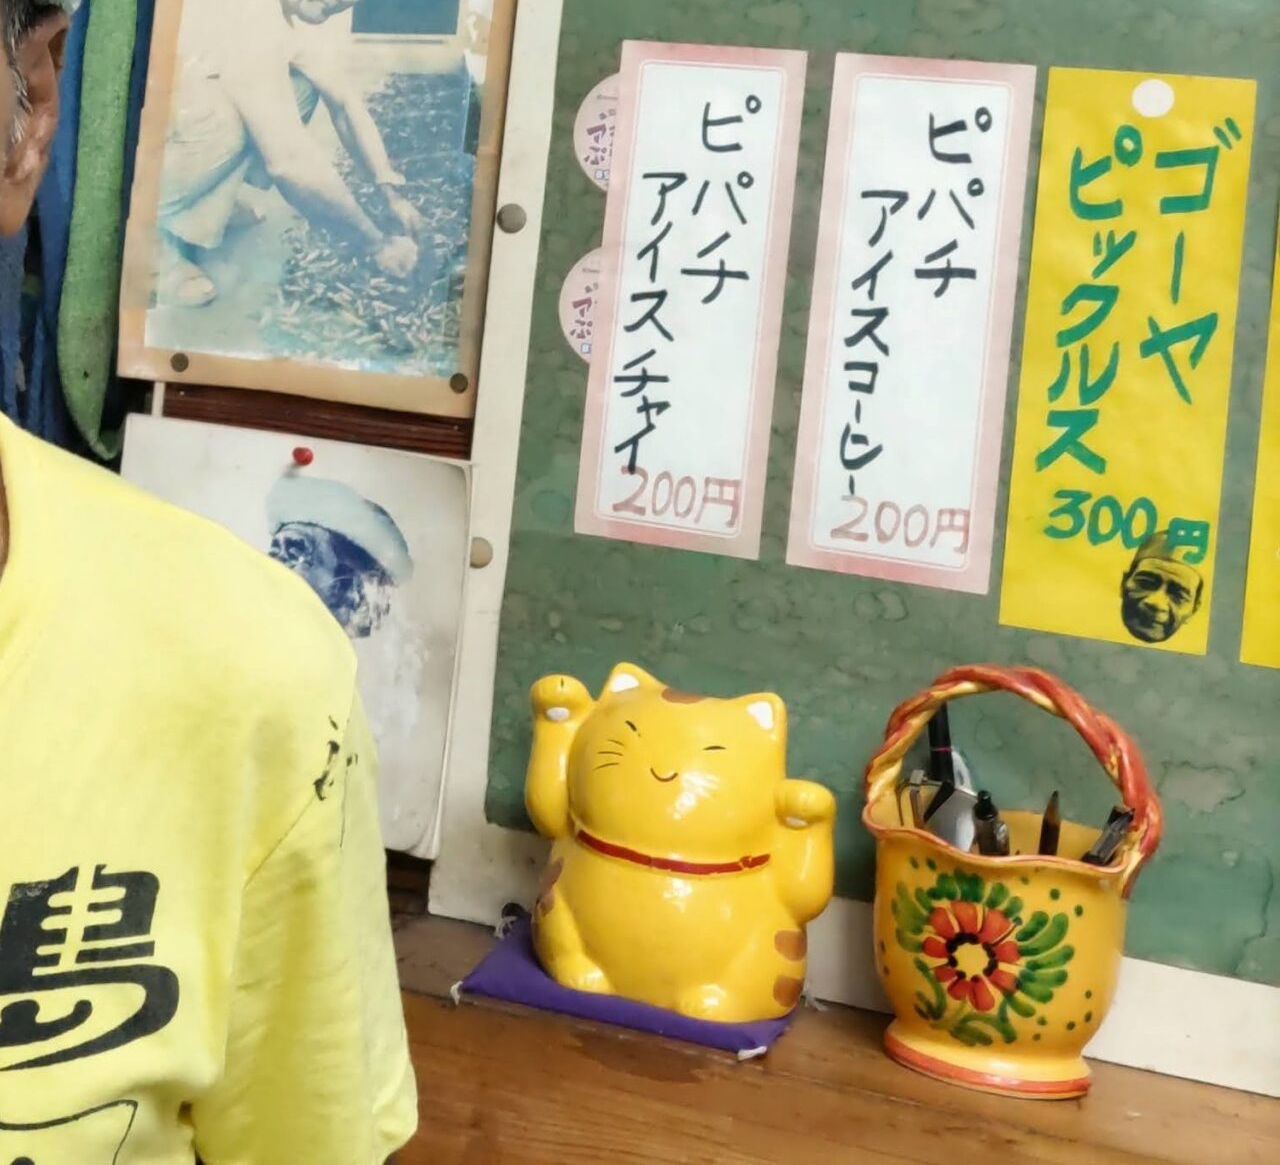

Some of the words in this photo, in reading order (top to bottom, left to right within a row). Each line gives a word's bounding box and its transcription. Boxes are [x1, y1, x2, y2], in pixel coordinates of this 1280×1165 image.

[681, 94, 762, 304] ピパチ
[914, 106, 993, 299] ピパチ
[1035, 124, 1143, 475] ピックルス
[1140, 116, 1243, 405] ゴーヤ
[613, 171, 688, 475] アイスチャイ
[611, 466, 741, 529] 200円
[829, 495, 972, 554] 200円
[1043, 488, 1211, 565] 300円
